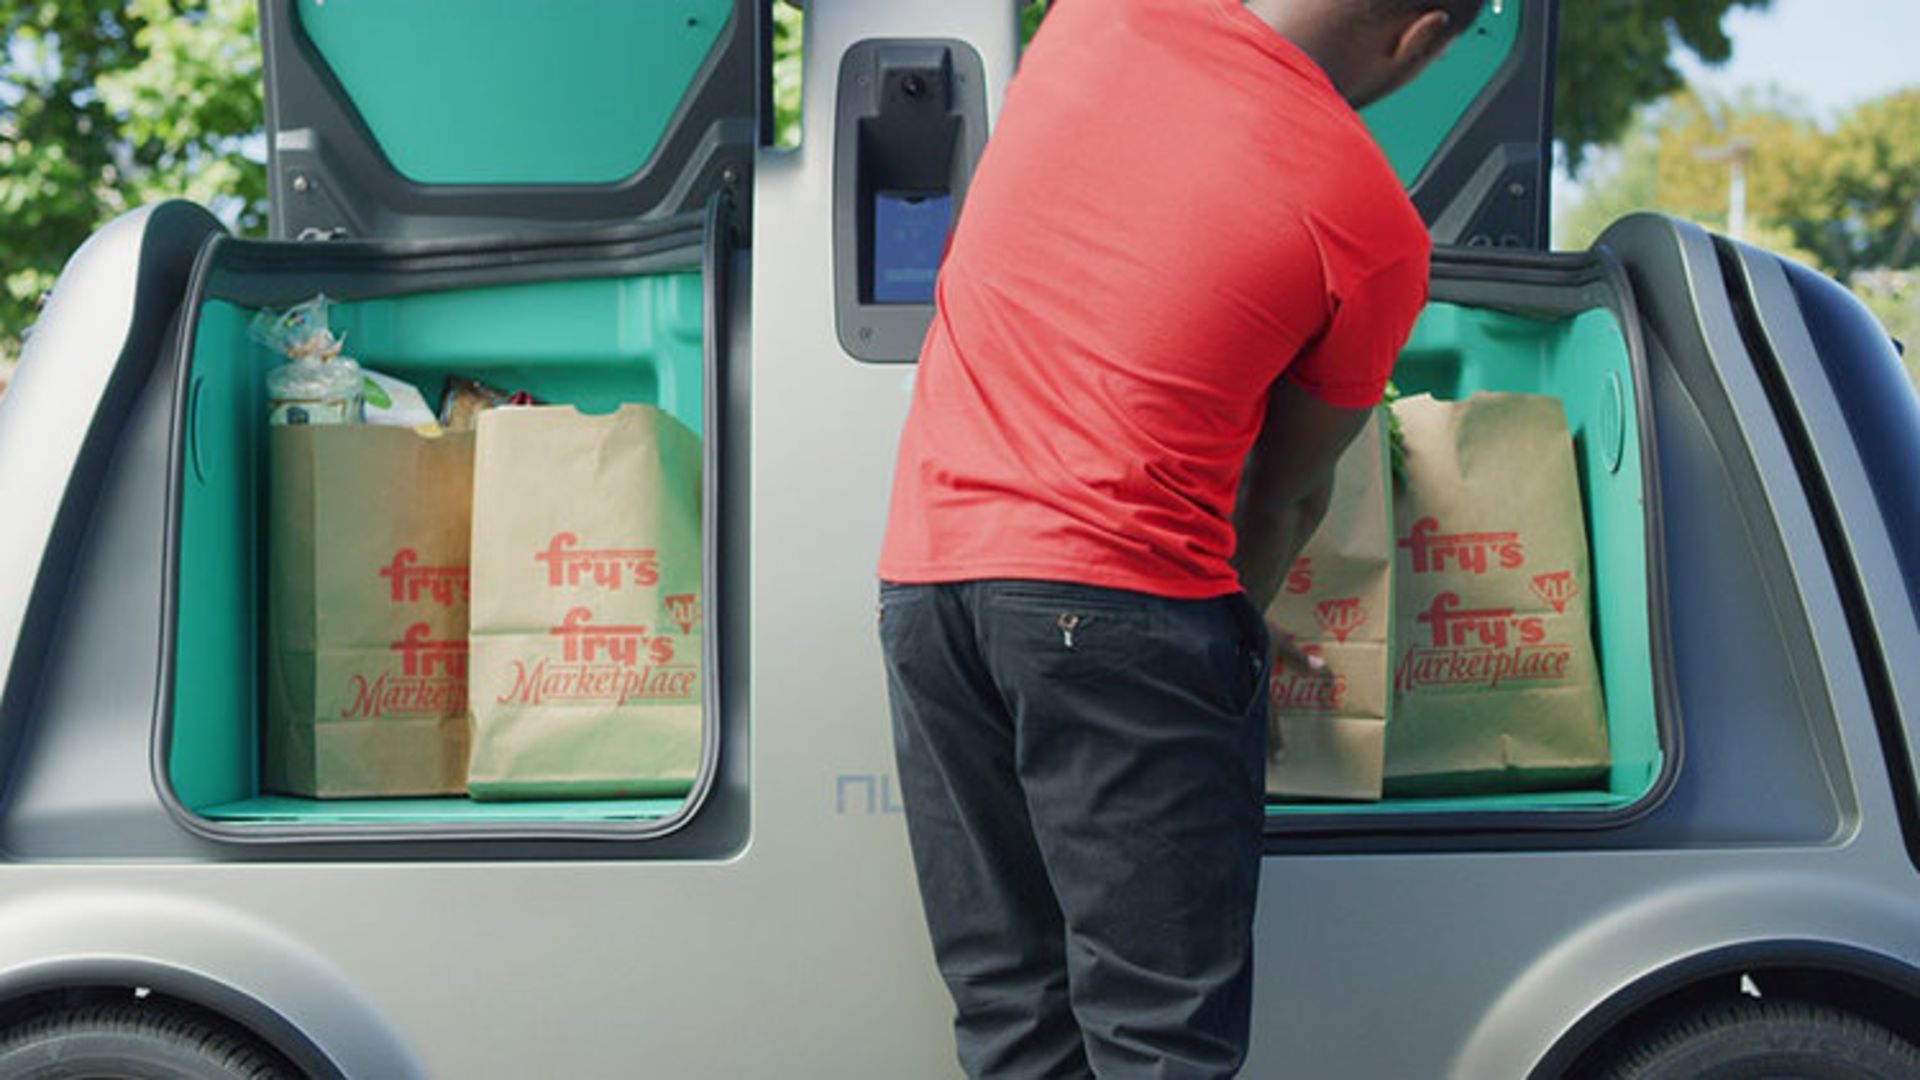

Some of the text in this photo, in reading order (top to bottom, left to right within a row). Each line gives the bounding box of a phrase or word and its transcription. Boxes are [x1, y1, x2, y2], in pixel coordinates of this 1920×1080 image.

[535, 532, 659, 589] fry's
[1396, 517, 1524, 575] fry's
[549, 607, 674, 665] fry's
[1417, 591, 1545, 648] fry's
[496, 657, 697, 707] Marketplace
